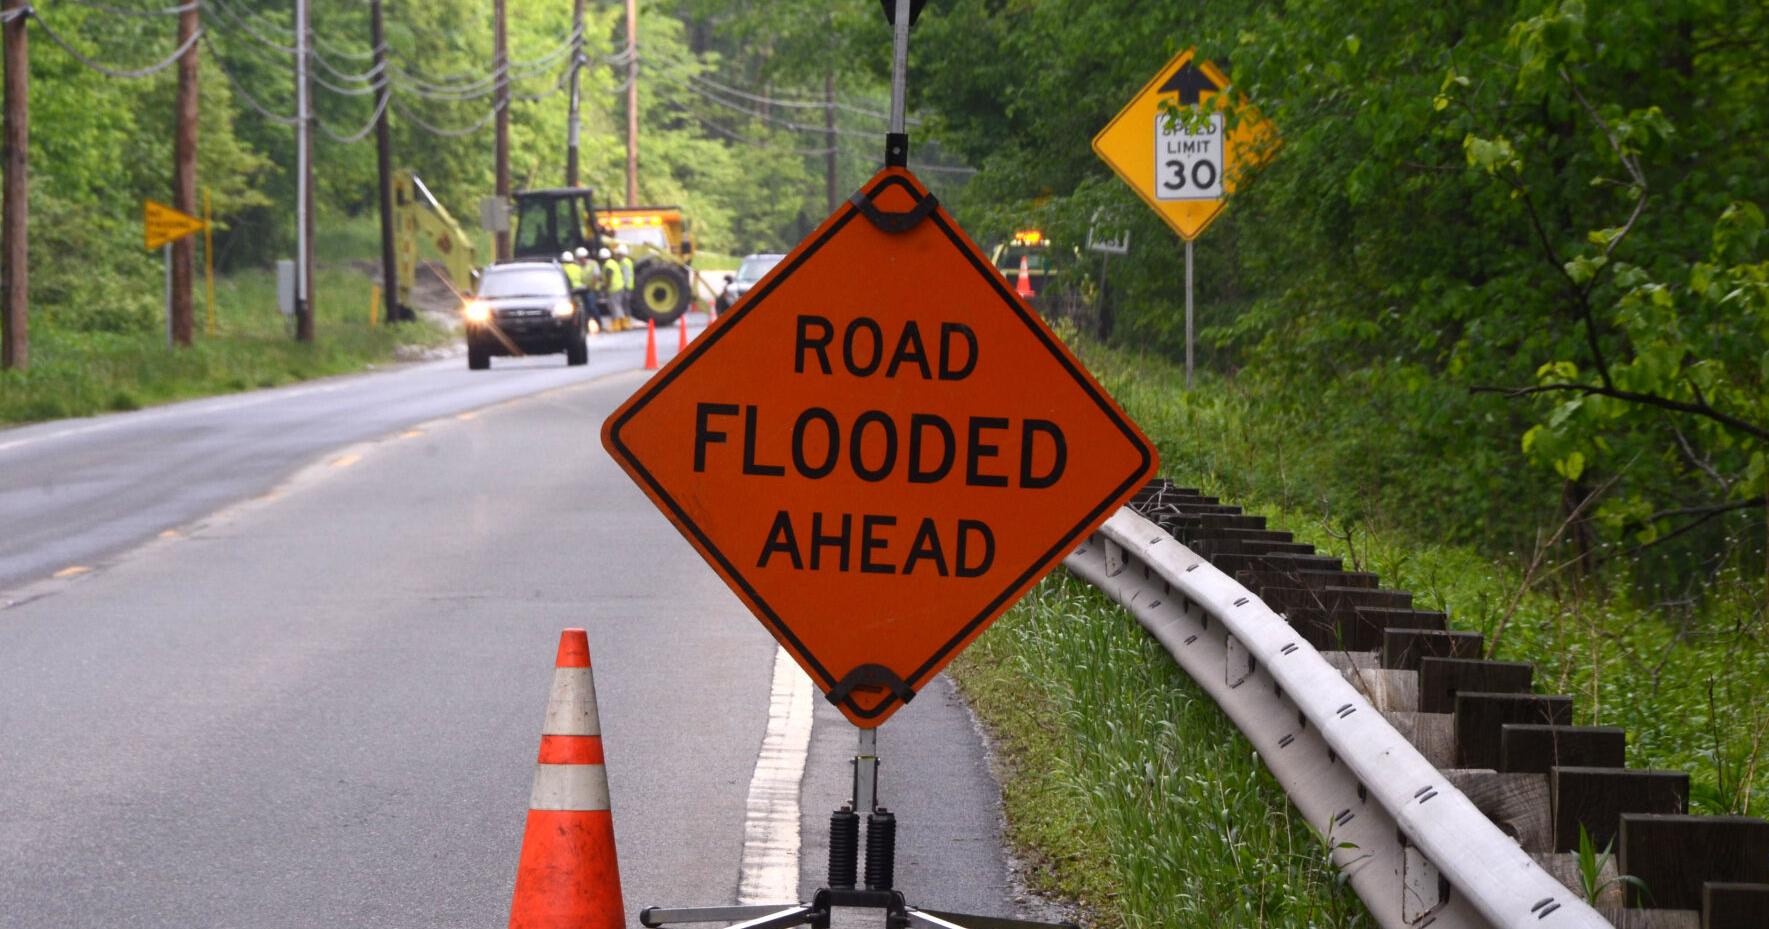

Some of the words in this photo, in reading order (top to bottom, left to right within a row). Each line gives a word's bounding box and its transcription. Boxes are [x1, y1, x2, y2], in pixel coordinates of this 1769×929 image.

[1163, 160, 1216, 190] 30
[1167, 140, 1211, 154] LIMIT
[794, 314, 980, 381] ROAD
[693, 402, 1068, 489] FLOODED
[756, 510, 996, 578] AHEAD
